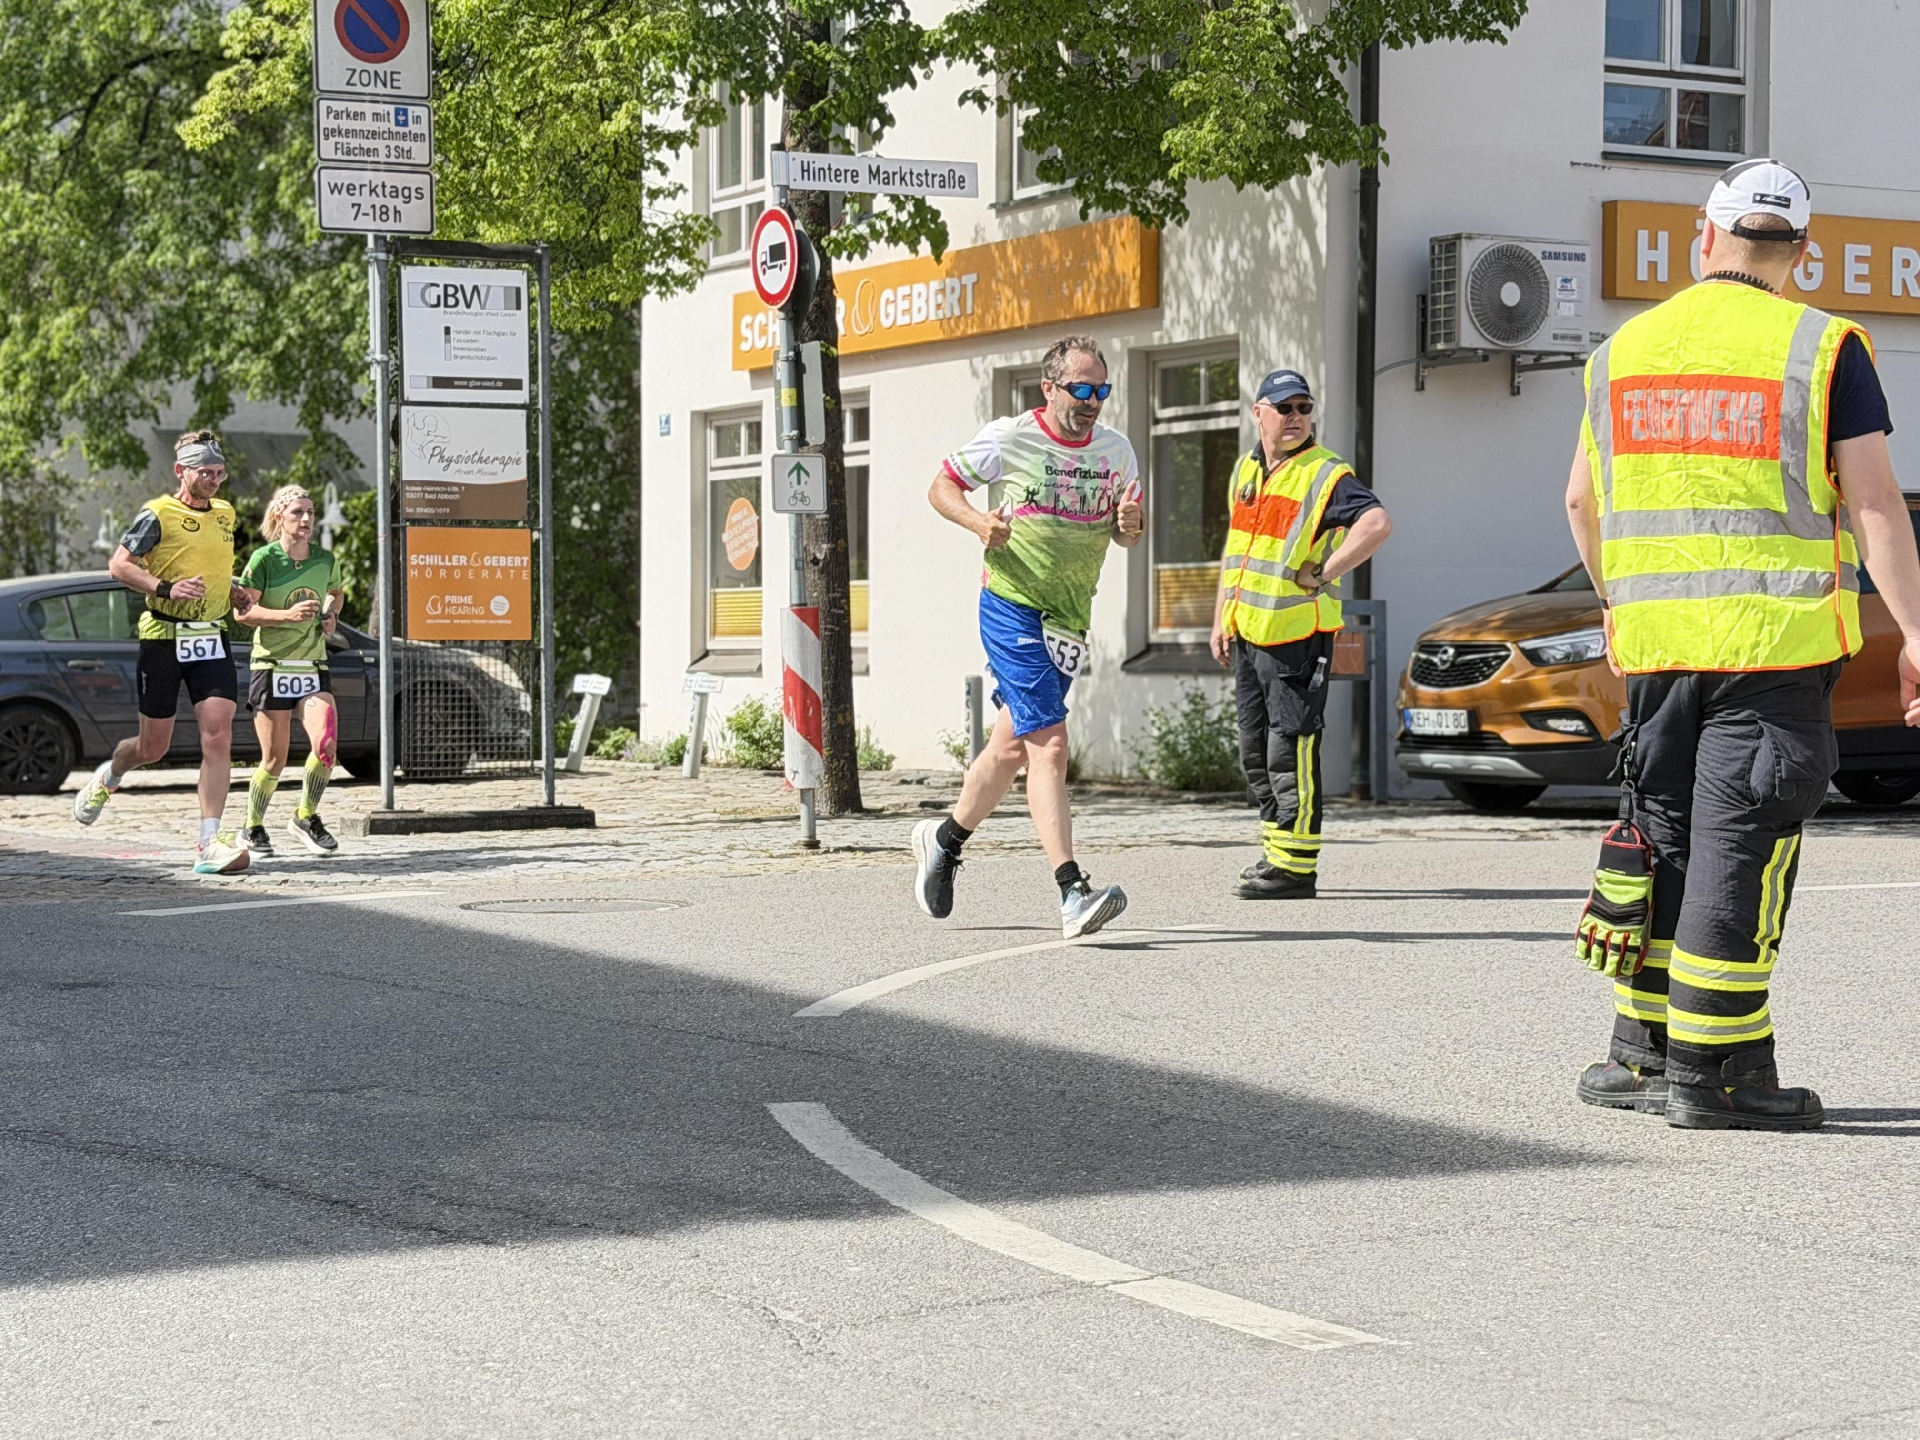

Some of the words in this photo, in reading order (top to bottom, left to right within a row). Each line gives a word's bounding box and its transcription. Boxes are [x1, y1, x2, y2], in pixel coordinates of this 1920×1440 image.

[345, 68, 402, 90] ZONE
[326, 106, 366, 122] Parken
[372, 109, 391, 124] mit
[411, 110, 422, 126] in
[323, 124, 426, 143] gekennzeichneten
[334, 141, 379, 158] Flächen
[800, 160, 860, 184] Hintere
[868, 164, 967, 191] Marktstraße
[327, 180, 425, 204] werktags
[1541, 251, 1587, 262] SAMSUNG
[420, 282, 492, 310] GBW
[879, 272, 979, 329] GEBERT
[1622, 388, 1765, 444] FEUERWEHR
[428, 445, 522, 473] Physiotherapie
[1045, 465, 1111, 480] Benefizlauf
[410, 554, 468, 566] SCHILLER
[483, 555, 529, 567] GEBERT
[410, 568, 530, 580] HÖRGERÄTE
[179, 637, 218, 660] 567
[276, 675, 317, 695] 603
